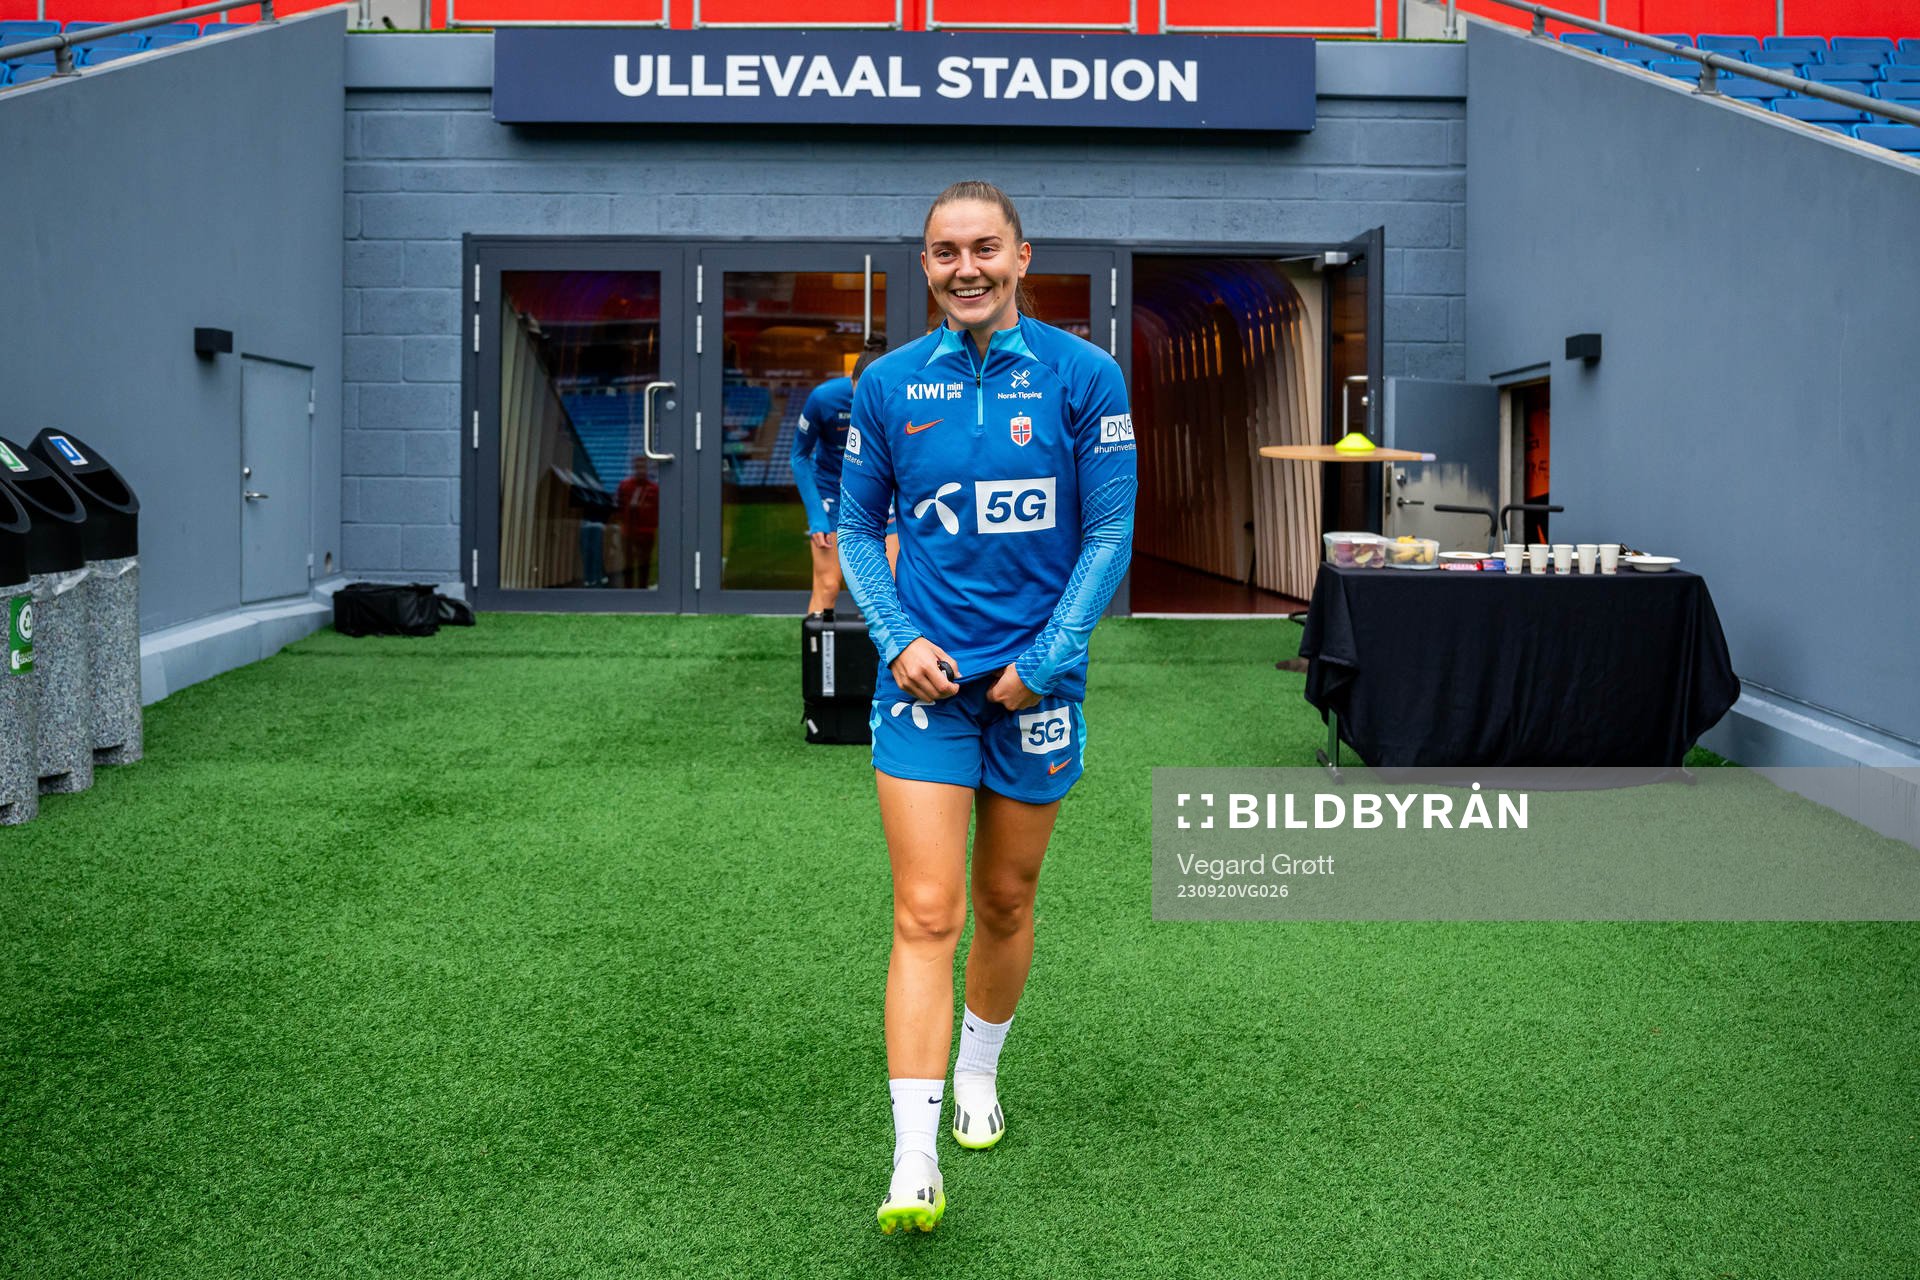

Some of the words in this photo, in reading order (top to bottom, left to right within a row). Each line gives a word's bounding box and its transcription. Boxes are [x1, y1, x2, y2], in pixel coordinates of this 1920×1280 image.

[613, 54, 920, 98] ULLEVAAL
[936, 56, 1197, 102] STADION
[906, 383, 944, 400] KIWI
[946, 381, 963, 391] mini
[946, 390, 961, 400] pris
[1018, 391, 1042, 399] Tipping
[985, 488, 1047, 524] 5G
[1028, 717, 1066, 747] 5G
